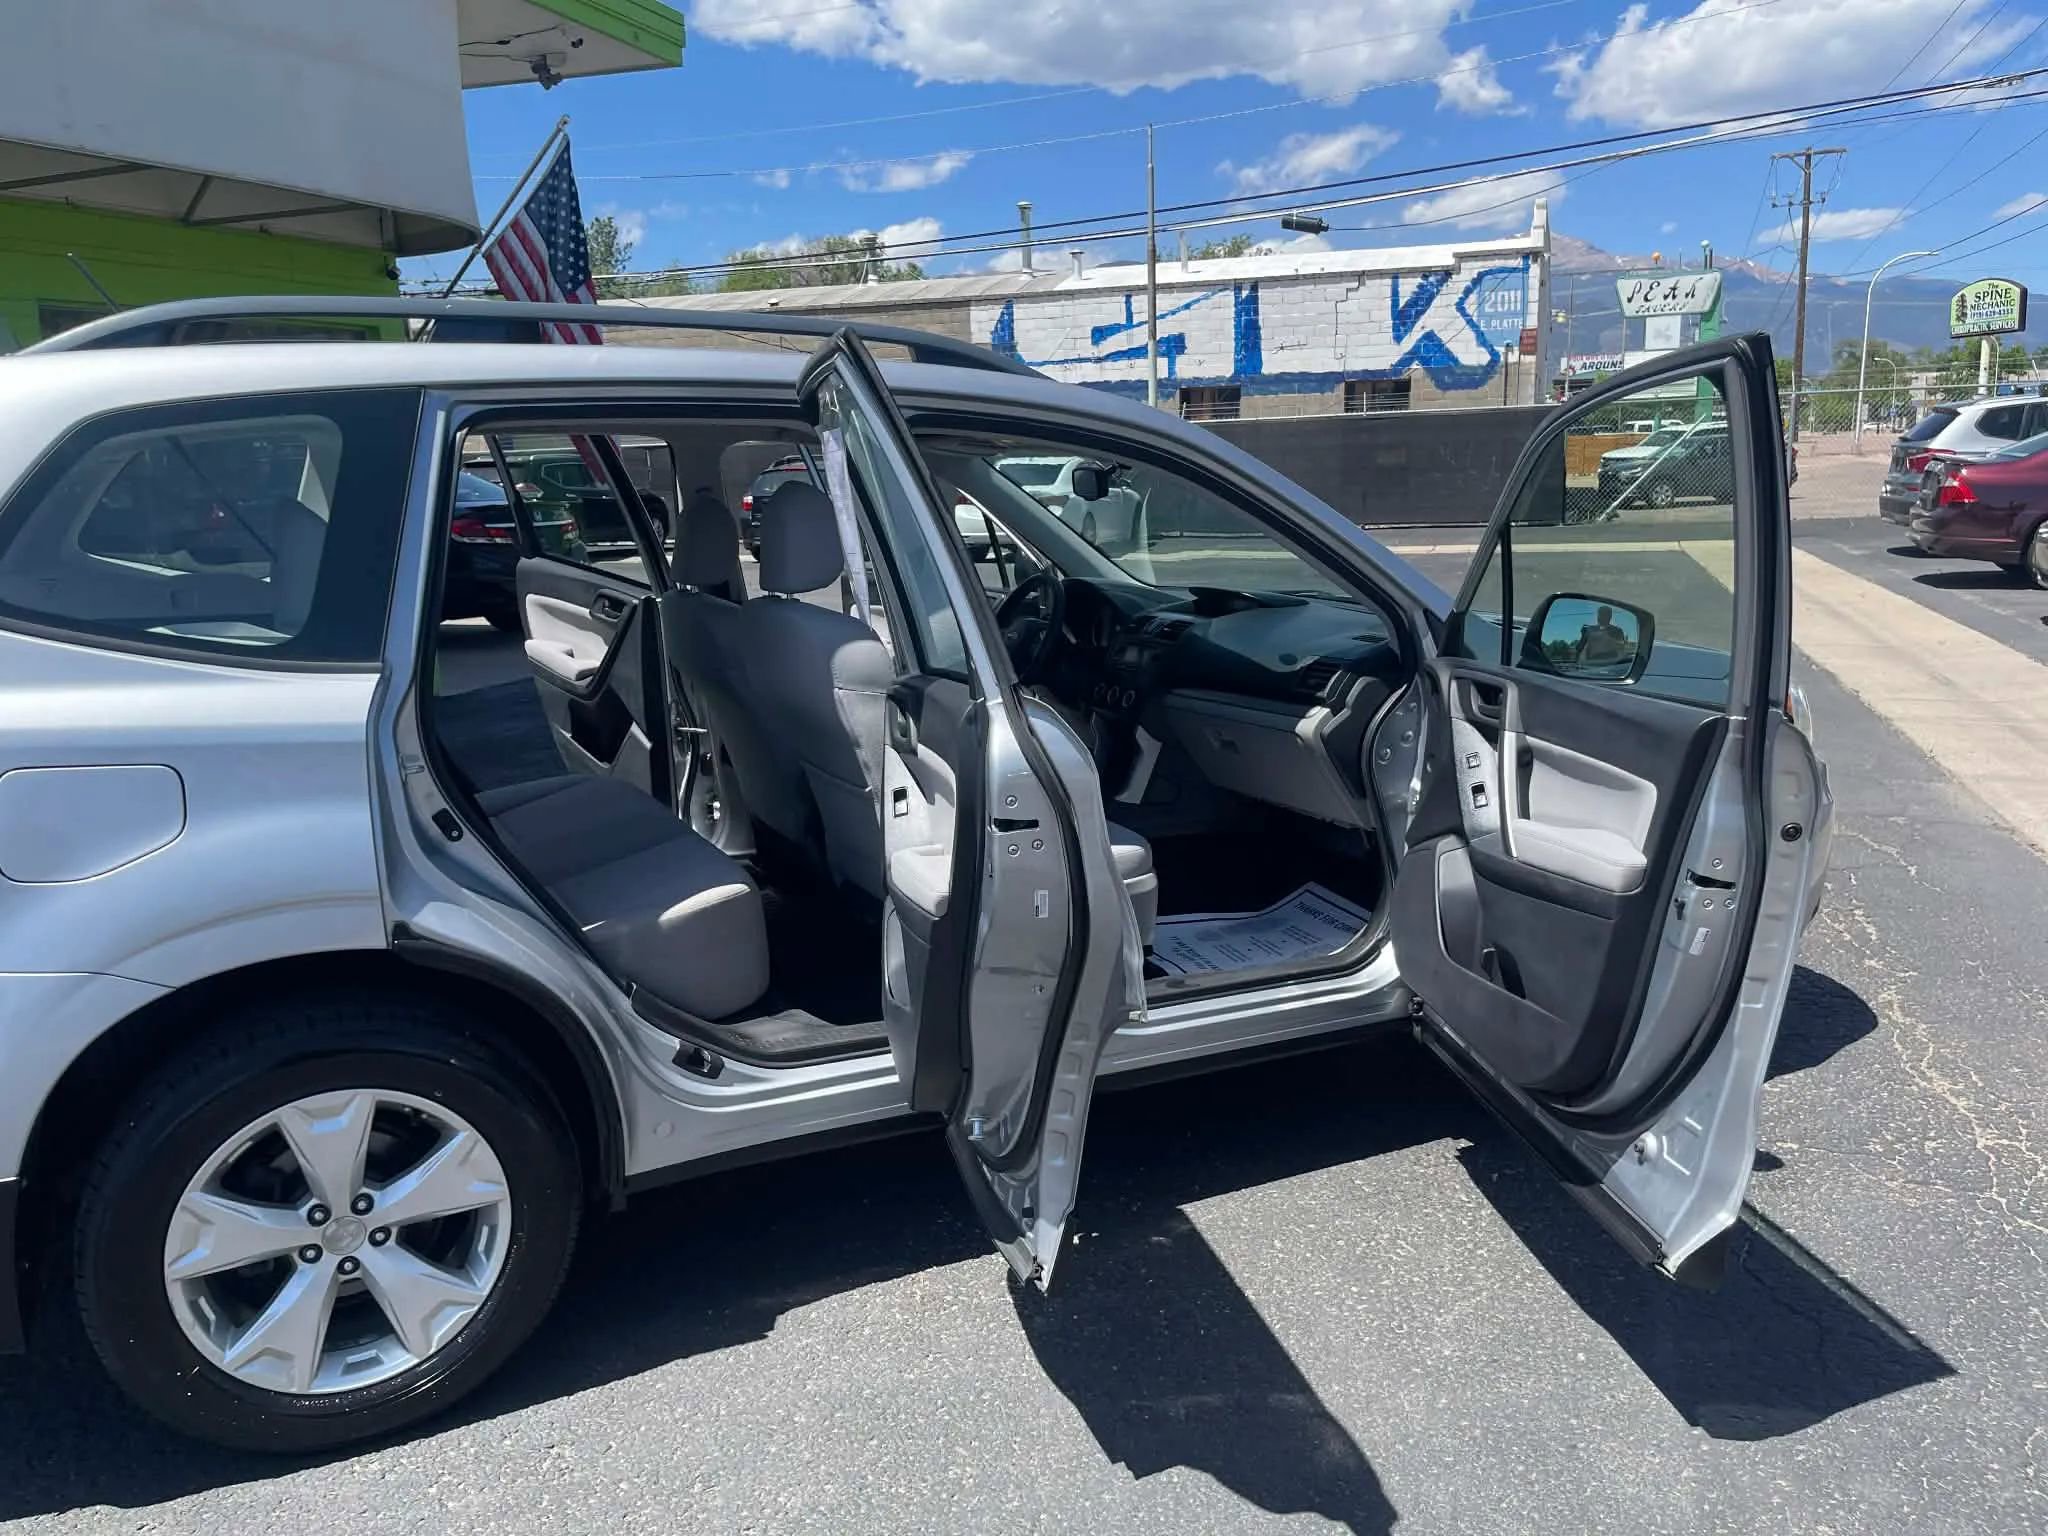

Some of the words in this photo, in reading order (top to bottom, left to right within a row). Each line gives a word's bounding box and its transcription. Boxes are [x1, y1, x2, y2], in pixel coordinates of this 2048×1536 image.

[1484, 290, 1521, 313] 2011
[1974, 288, 2012, 303] SPINE
[1969, 299, 2016, 311] MECHANIC
[1480, 319, 1486, 330] E
[1491, 318, 1523, 330] PLATTE
